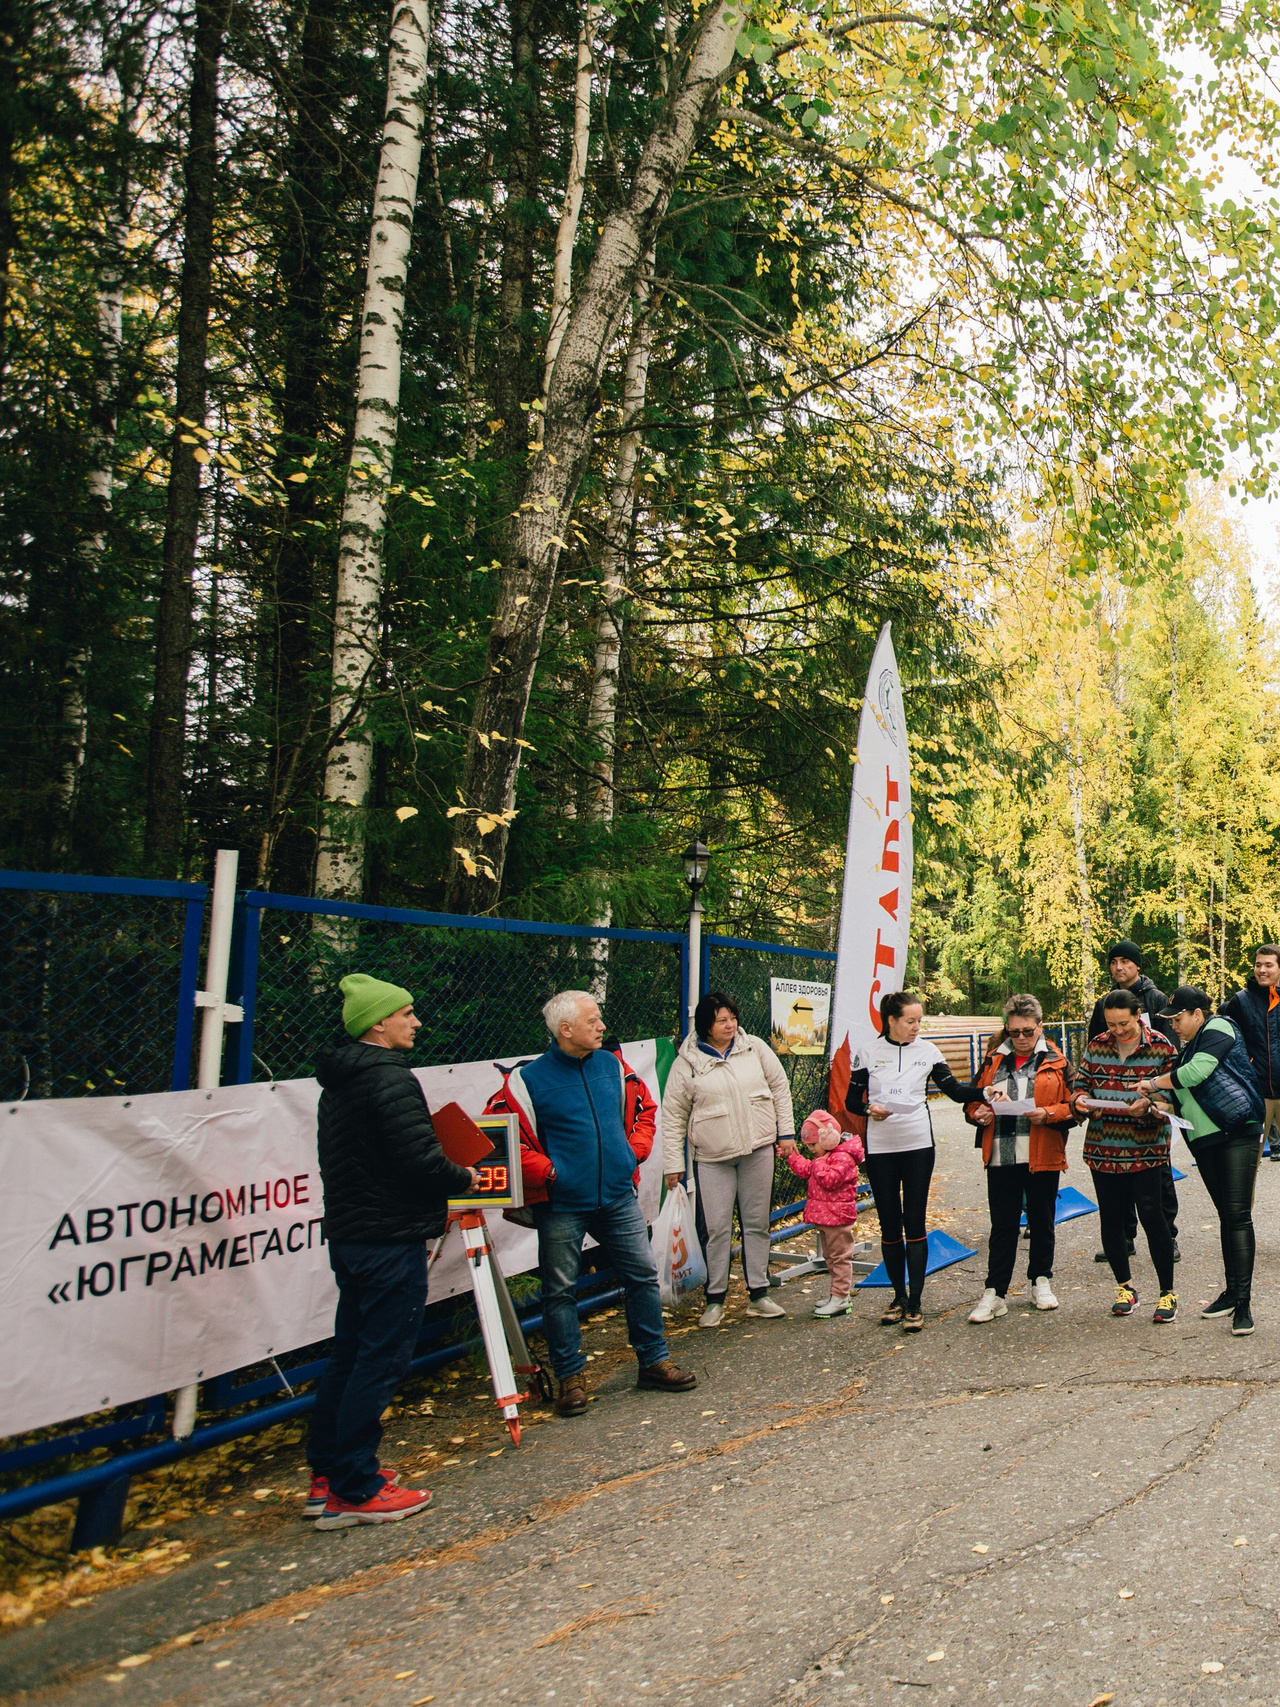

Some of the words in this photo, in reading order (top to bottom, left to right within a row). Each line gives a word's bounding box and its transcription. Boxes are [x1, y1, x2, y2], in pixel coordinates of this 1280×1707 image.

[775, 982, 798, 994] АЛЛЕЯ
[799, 985, 829, 997] ЗДОРОВЬЯ
[888, 1087, 902, 1096] 405
[479, 1166, 508, 1190] 39
[49, 1173, 310, 1250] АВТОНОМНОЕ
[47, 1217, 326, 1304] «ЮГРАМЕГАСП
